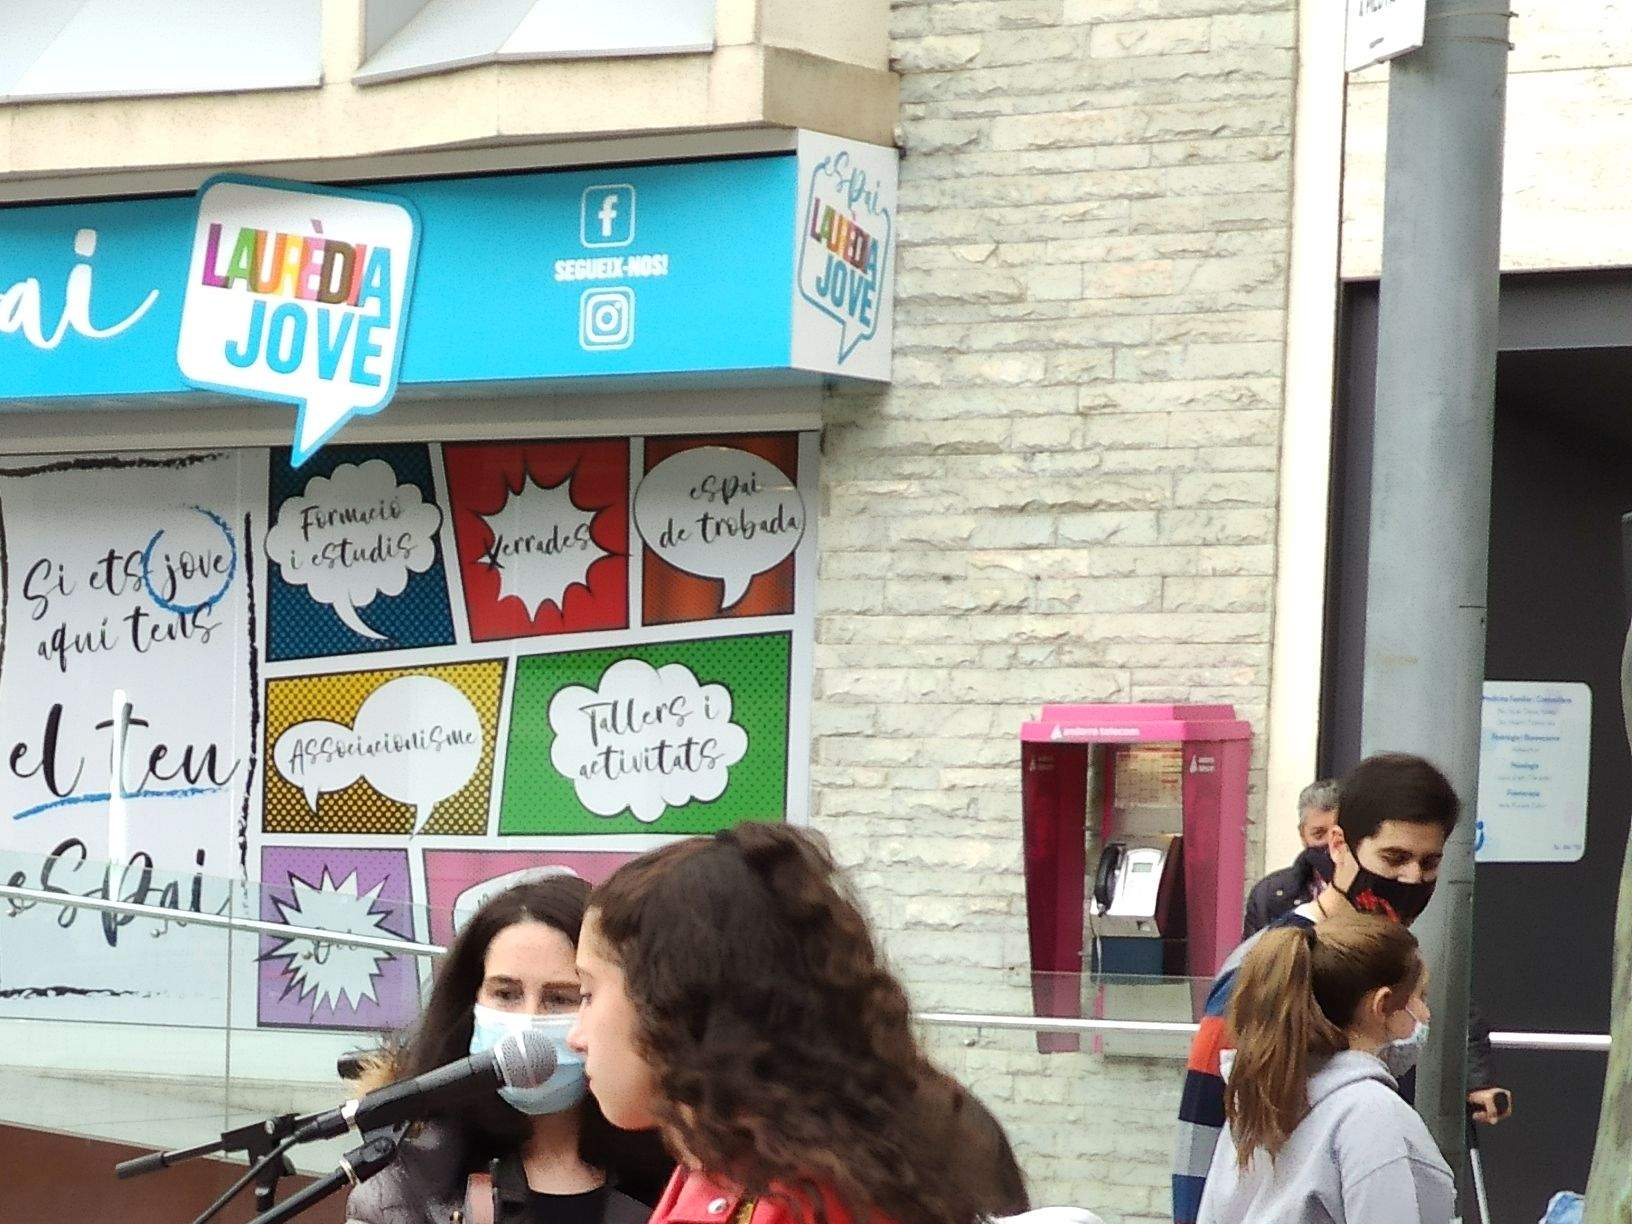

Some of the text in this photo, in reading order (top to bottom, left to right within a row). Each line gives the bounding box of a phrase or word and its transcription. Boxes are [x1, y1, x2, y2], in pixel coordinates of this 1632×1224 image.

[202, 219, 392, 328] LAURÈDIA
[815, 253, 876, 328] JOVE
[224, 299, 392, 387] JOVE
[290, 532, 418, 570] i estudis
[659, 503, 799, 548] de trobada
[22, 548, 228, 621] Si ets jove
[122, 601, 223, 654] tens
[9, 702, 241, 798] el teu
[287, 725, 478, 775] Associacionisme
[579, 695, 720, 747] Tallers i
[579, 736, 726, 780] activitats
[6, 837, 232, 948] espai
